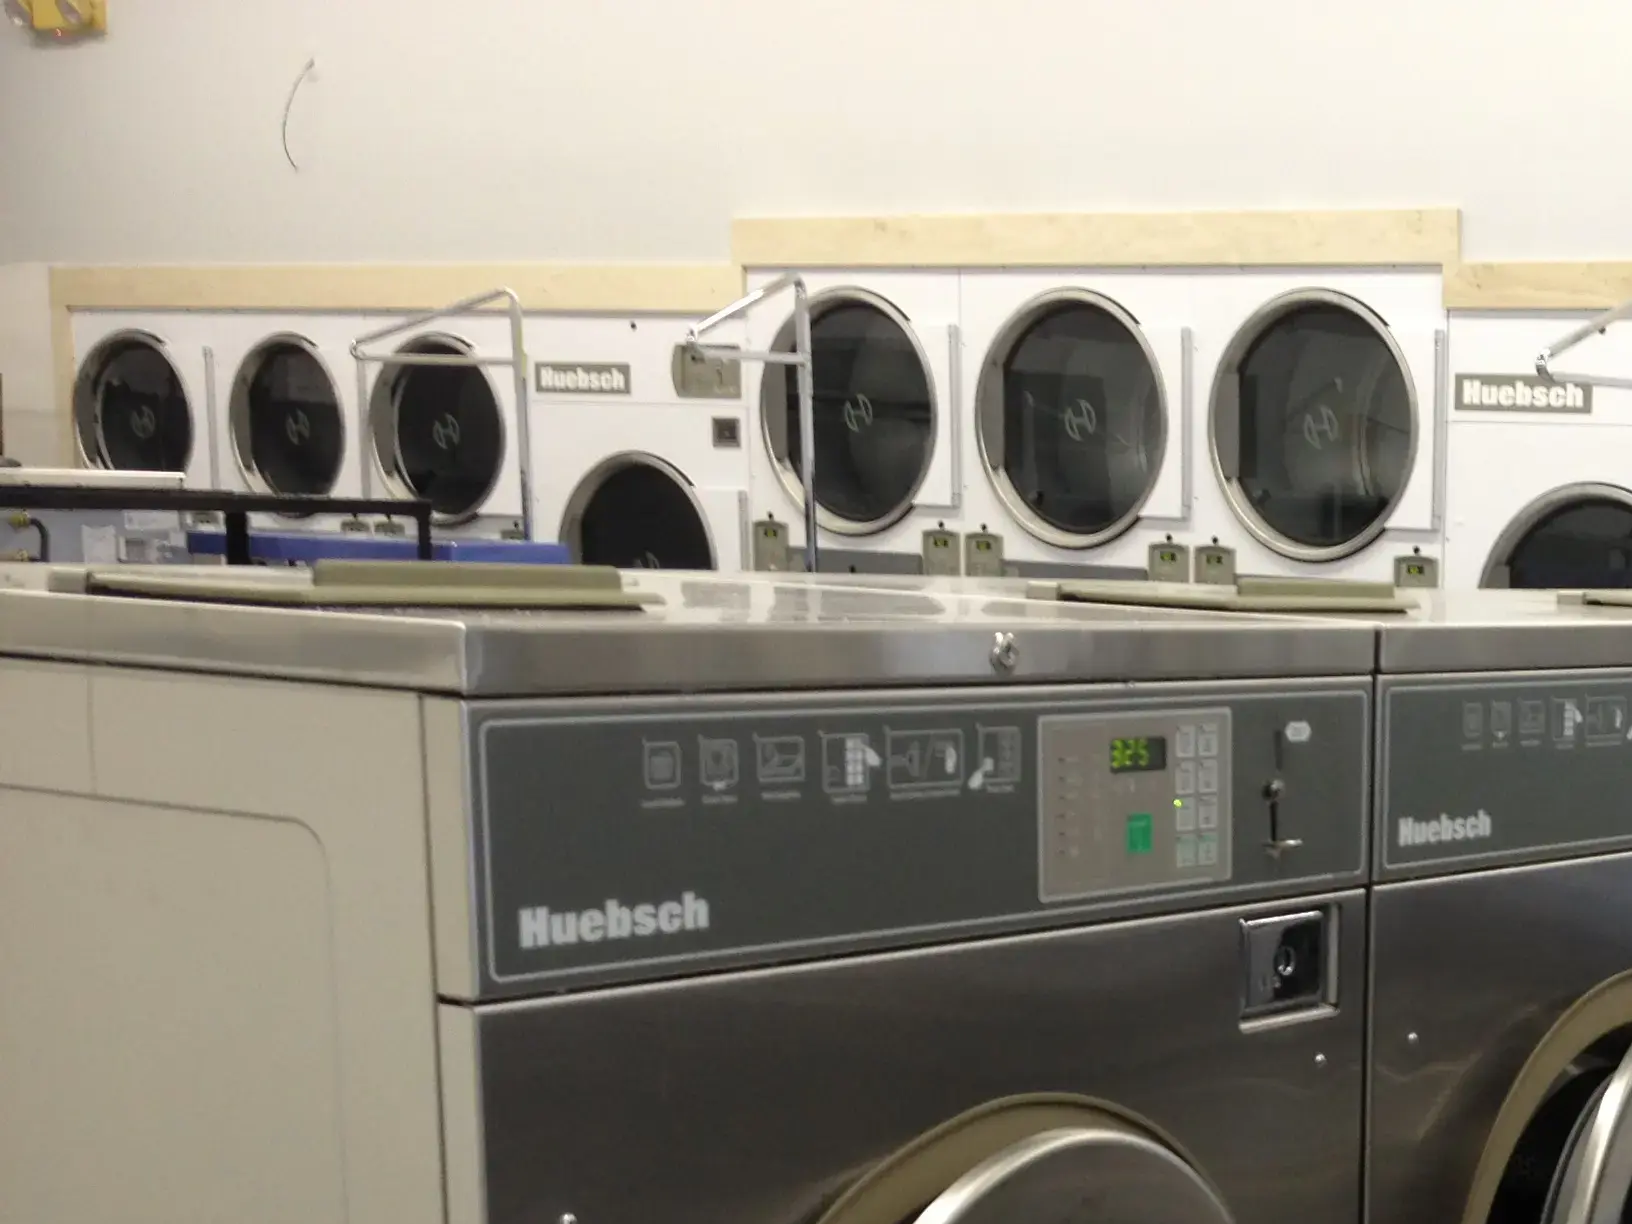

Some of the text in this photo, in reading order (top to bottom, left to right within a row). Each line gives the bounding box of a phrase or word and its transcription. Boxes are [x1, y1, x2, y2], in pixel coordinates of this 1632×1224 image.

[541, 366, 625, 391] Huebsch
[1462, 379, 1584, 408] Huebsch
[1398, 808, 1491, 847] Huebsch
[519, 890, 710, 948] Huebsch
